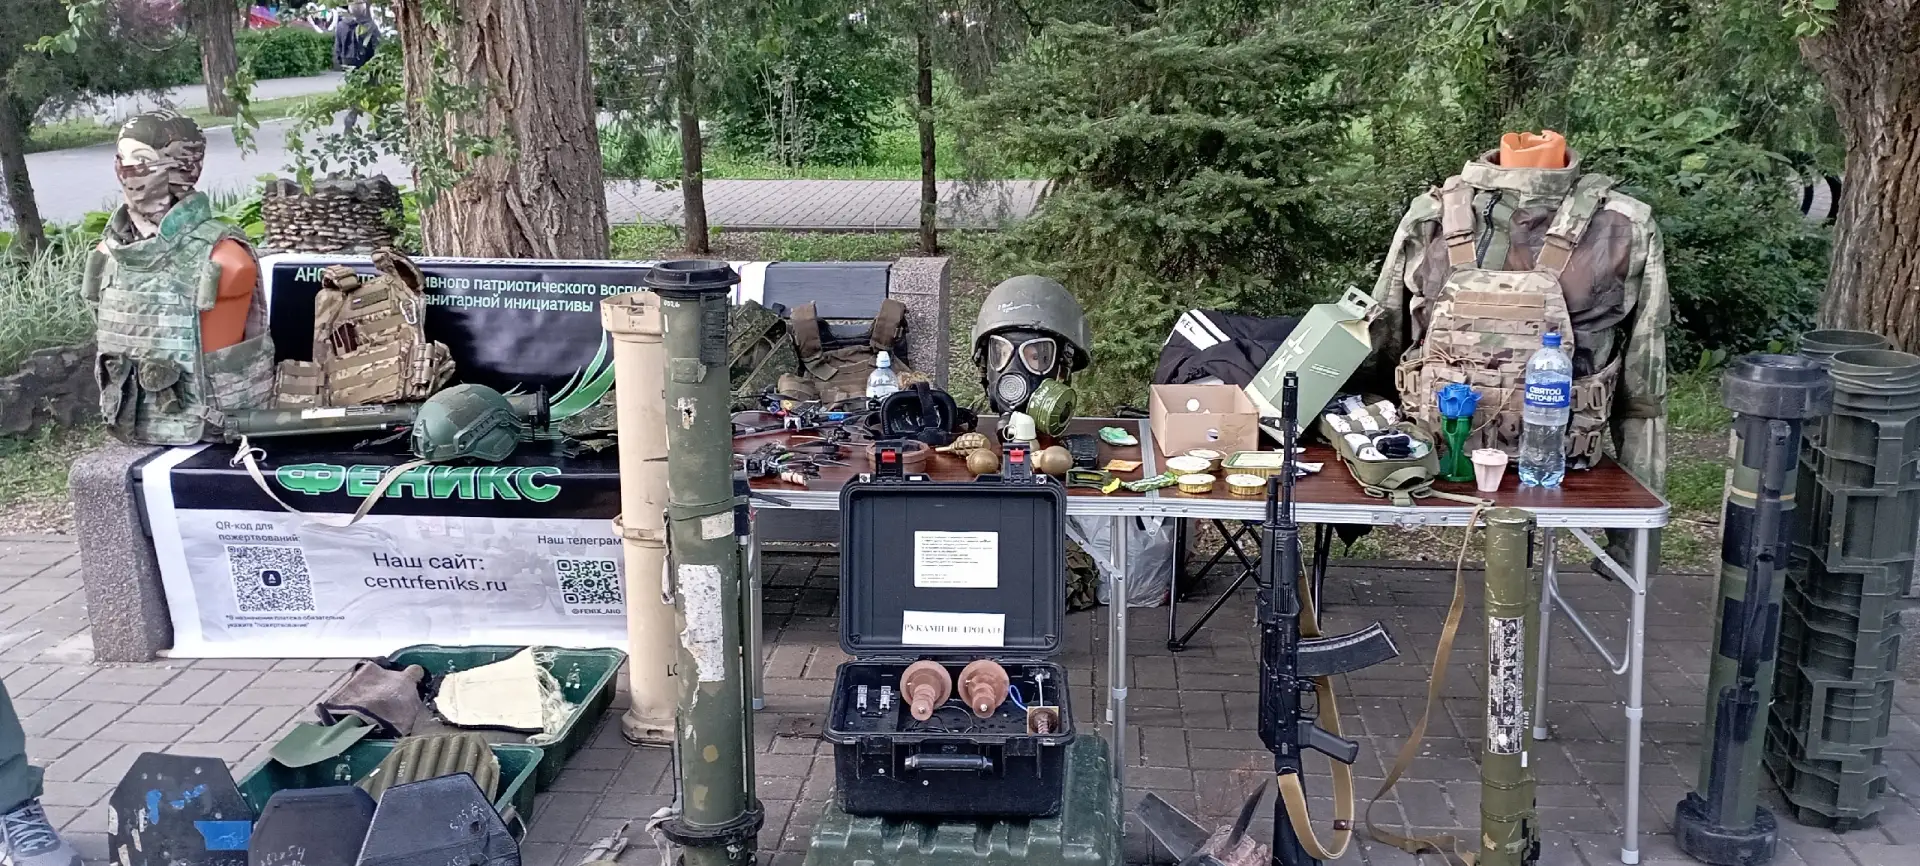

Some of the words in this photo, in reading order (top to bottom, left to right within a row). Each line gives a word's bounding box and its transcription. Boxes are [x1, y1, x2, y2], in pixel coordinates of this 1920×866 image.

[474, 279, 596, 295] патриотического
[600, 284, 650, 296] воспит
[425, 292, 500, 309] анитарной
[504, 298, 593, 313] инициативы
[1530, 386, 1562, 396] СВЯТОЙ
[1526, 392, 1566, 403] ИСТОЧНИК
[275, 463, 562, 502] ФЕНИКС
[216, 521, 253, 531] QR-код
[255, 523, 274, 531] для
[219, 533, 300, 542] пожертвований:
[537, 535, 564, 545] Наш
[566, 537, 623, 547] телеграм
[372, 552, 423, 569] Наш
[429, 553, 485, 570] сайт:
[364, 575, 508, 592] centrfeniks.ru
[904, 624, 945, 633] РУКАМИ
[947, 625, 958, 633] НЕ
